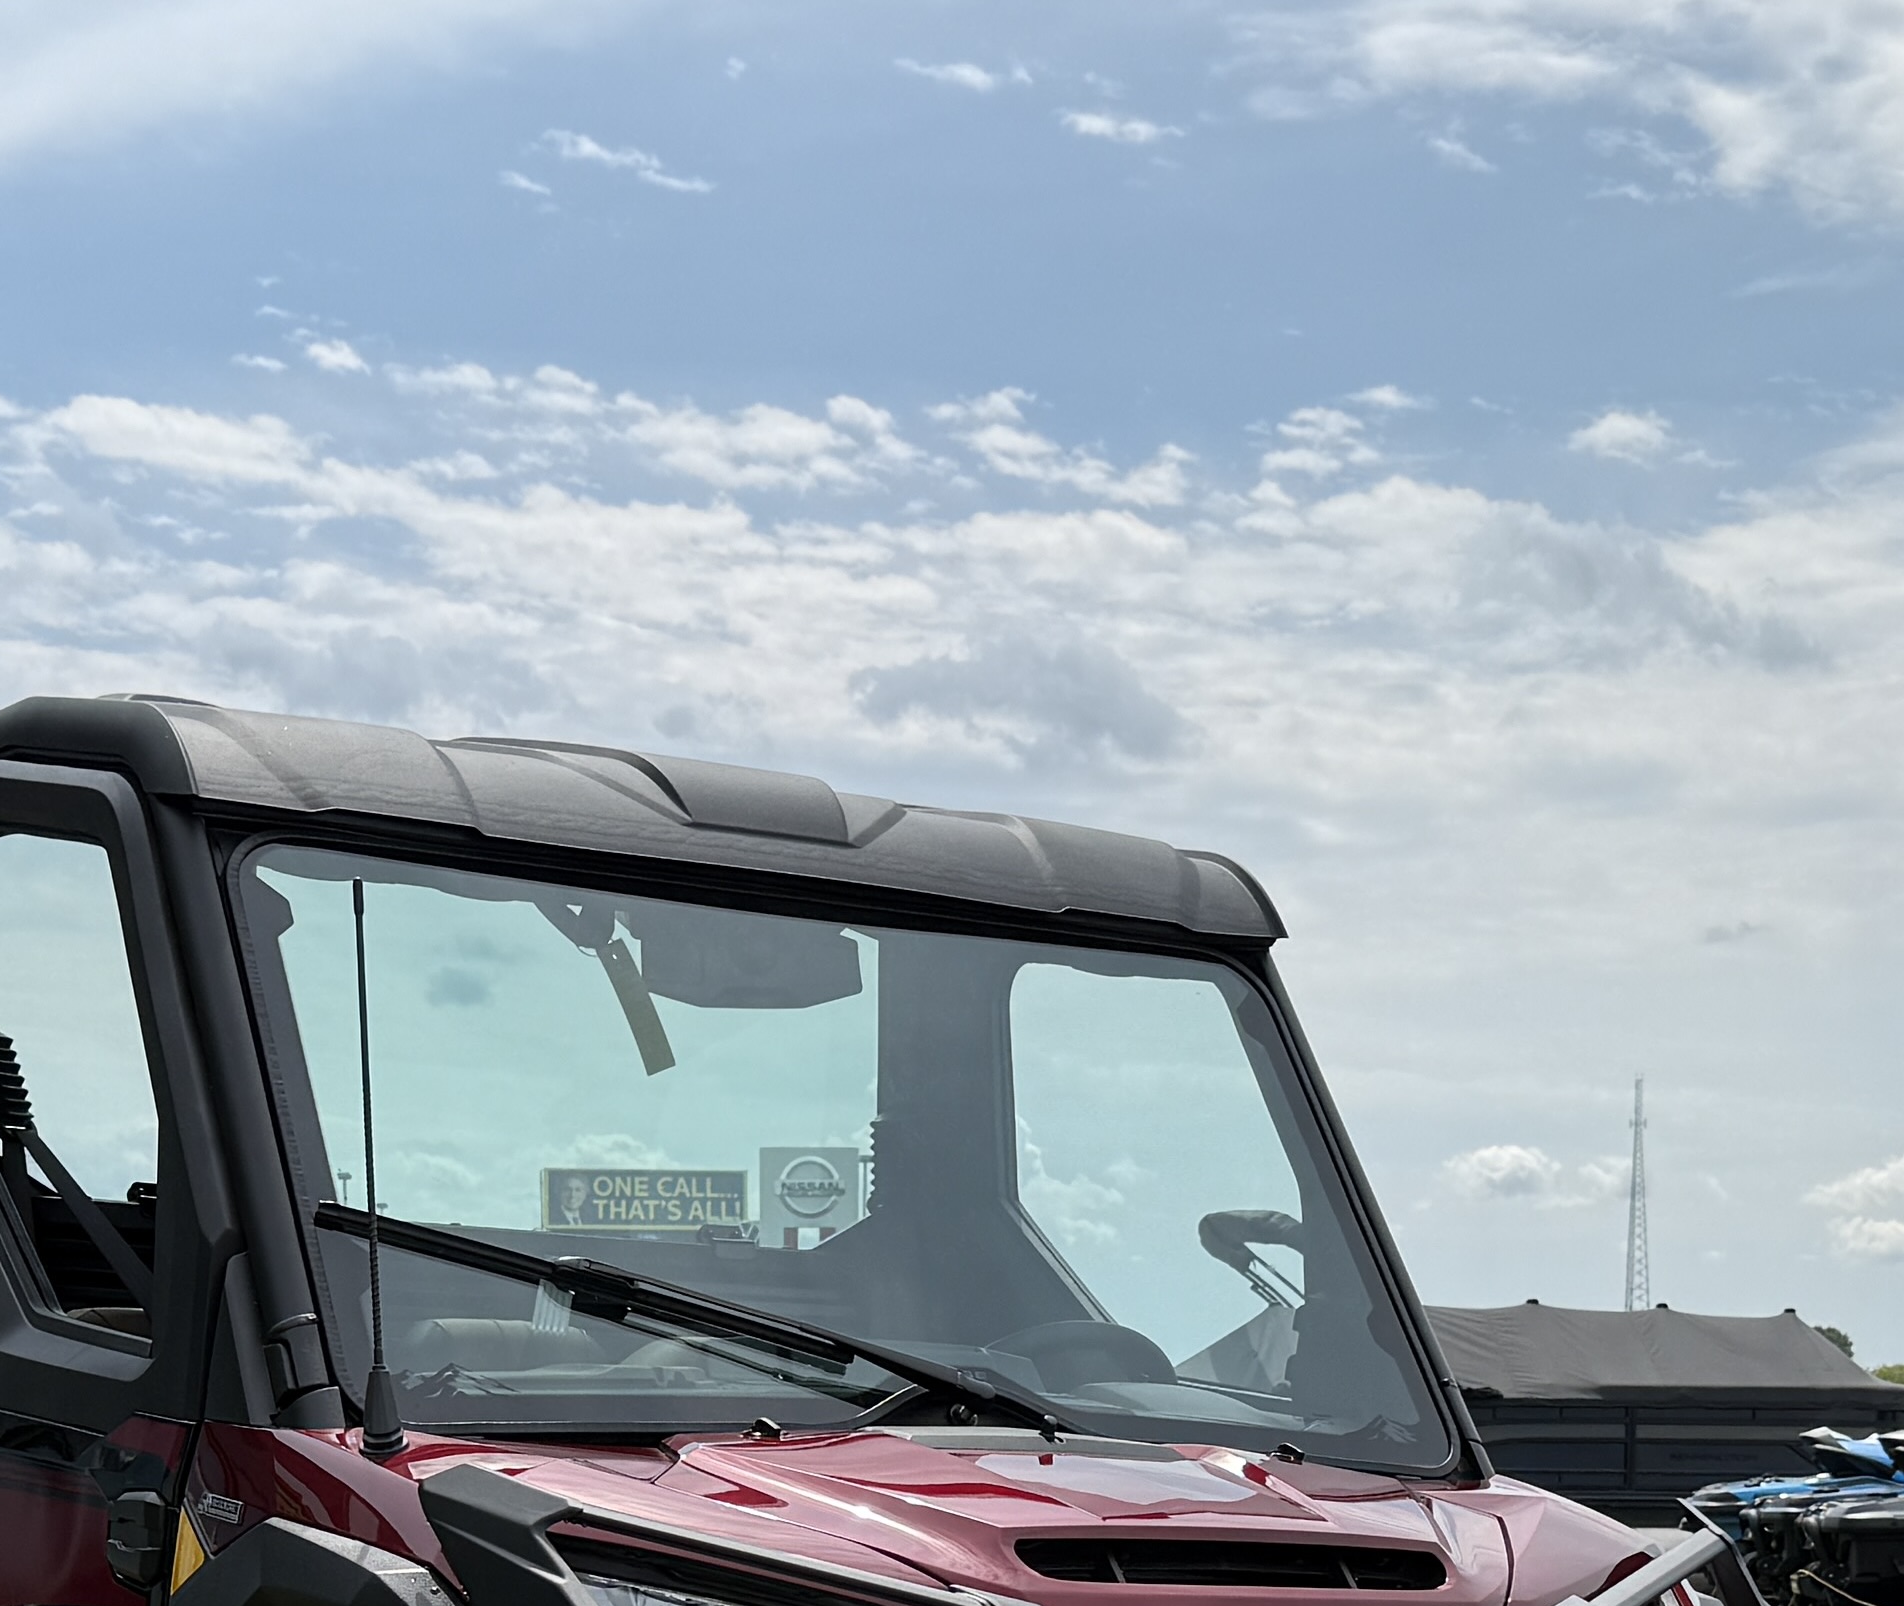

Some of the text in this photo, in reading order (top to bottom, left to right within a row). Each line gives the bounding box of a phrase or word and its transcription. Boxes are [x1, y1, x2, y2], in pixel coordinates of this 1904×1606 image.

[592, 1175, 738, 1198] ONE CALL...
[780, 1181, 840, 1191] NISSAN
[592, 1199, 741, 1223] THAT'S ALL!
